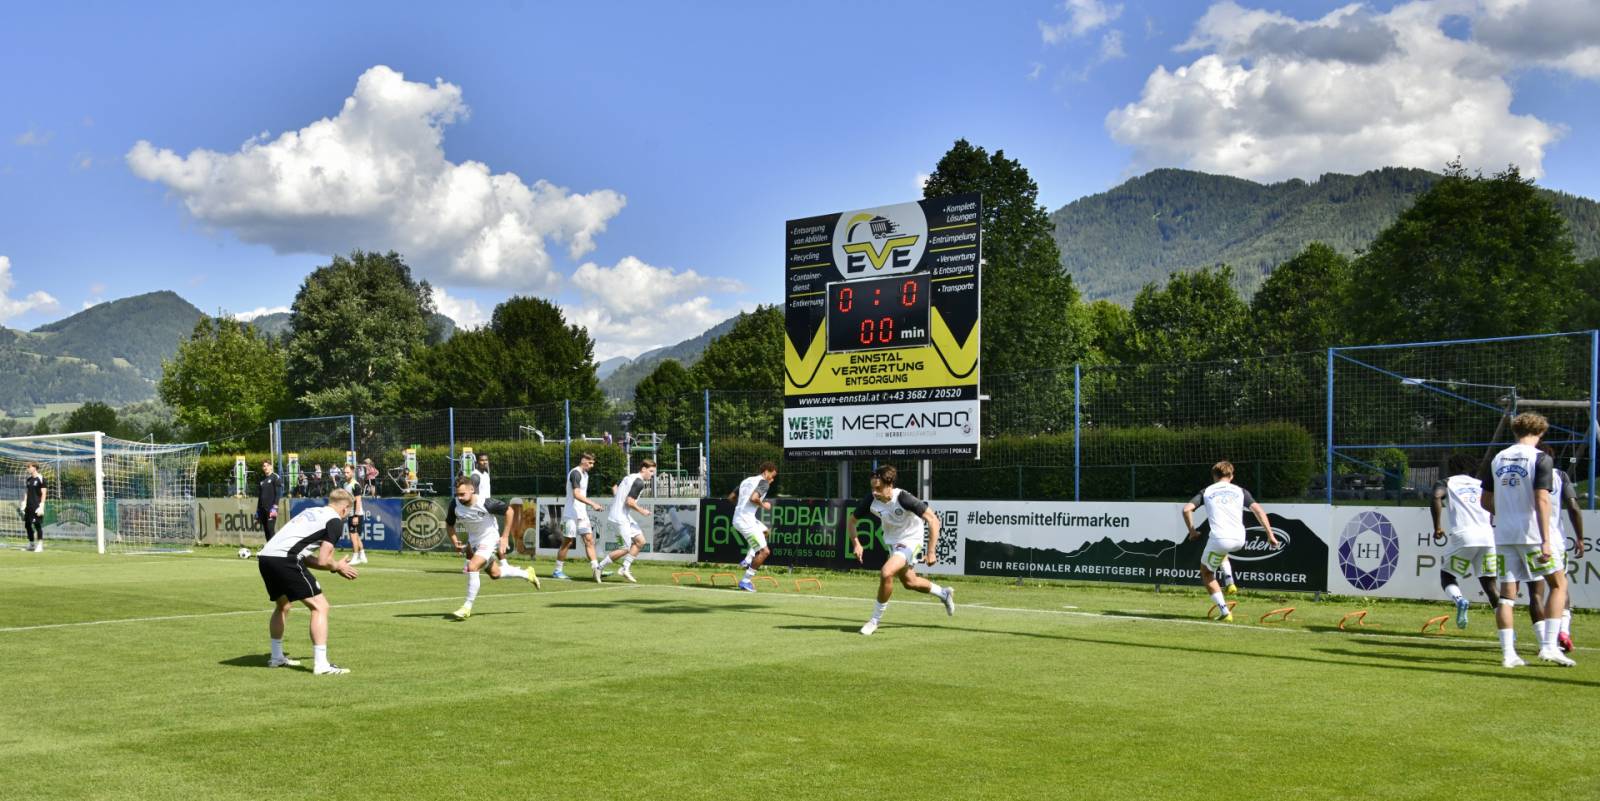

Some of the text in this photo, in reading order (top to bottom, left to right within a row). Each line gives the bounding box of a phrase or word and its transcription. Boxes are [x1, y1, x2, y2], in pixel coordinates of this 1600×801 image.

[946, 212, 977, 223] Lösungen
[793, 224, 826, 235] Entsorgung
[932, 232, 977, 245] Entrümpelung
[793, 252, 820, 262] Recycling
[842, 235, 920, 273] EVE
[940, 252, 976, 263] Verwertung
[933, 264, 974, 275] & Entsorgung
[792, 283, 810, 292] dienst
[941, 282, 974, 293] Transporte
[839, 287, 853, 313] 0
[903, 280, 917, 306] 0
[860, 317, 925, 344] 00 min
[850, 352, 903, 364] ENNSTAL
[832, 361, 924, 376] VERWERTUNG
[845, 373, 908, 386] ENTSORGUNG
[799, 392, 880, 405] www.eve-ennstal.at
[889, 391, 904, 400] +43
[906, 390, 927, 399] 3682
[934, 388, 962, 398] 20520
[788, 416, 808, 430] WE
[815, 416, 833, 428] WE
[842, 411, 969, 430] MERCANDO
[789, 431, 808, 440] LOVE
[816, 428, 833, 440] DO!
[225, 509, 262, 532] actua
[761, 506, 838, 527] ERDBAU
[967, 511, 1130, 528] #lebensmittelfürmarken
[768, 527, 836, 546] lfred köhl
[980, 560, 1003, 570] DEIN
[1006, 562, 1071, 573] REGIONALER
[1074, 564, 1145, 576] ARBEITGEBER
[1234, 570, 1307, 583] VERSORGER
